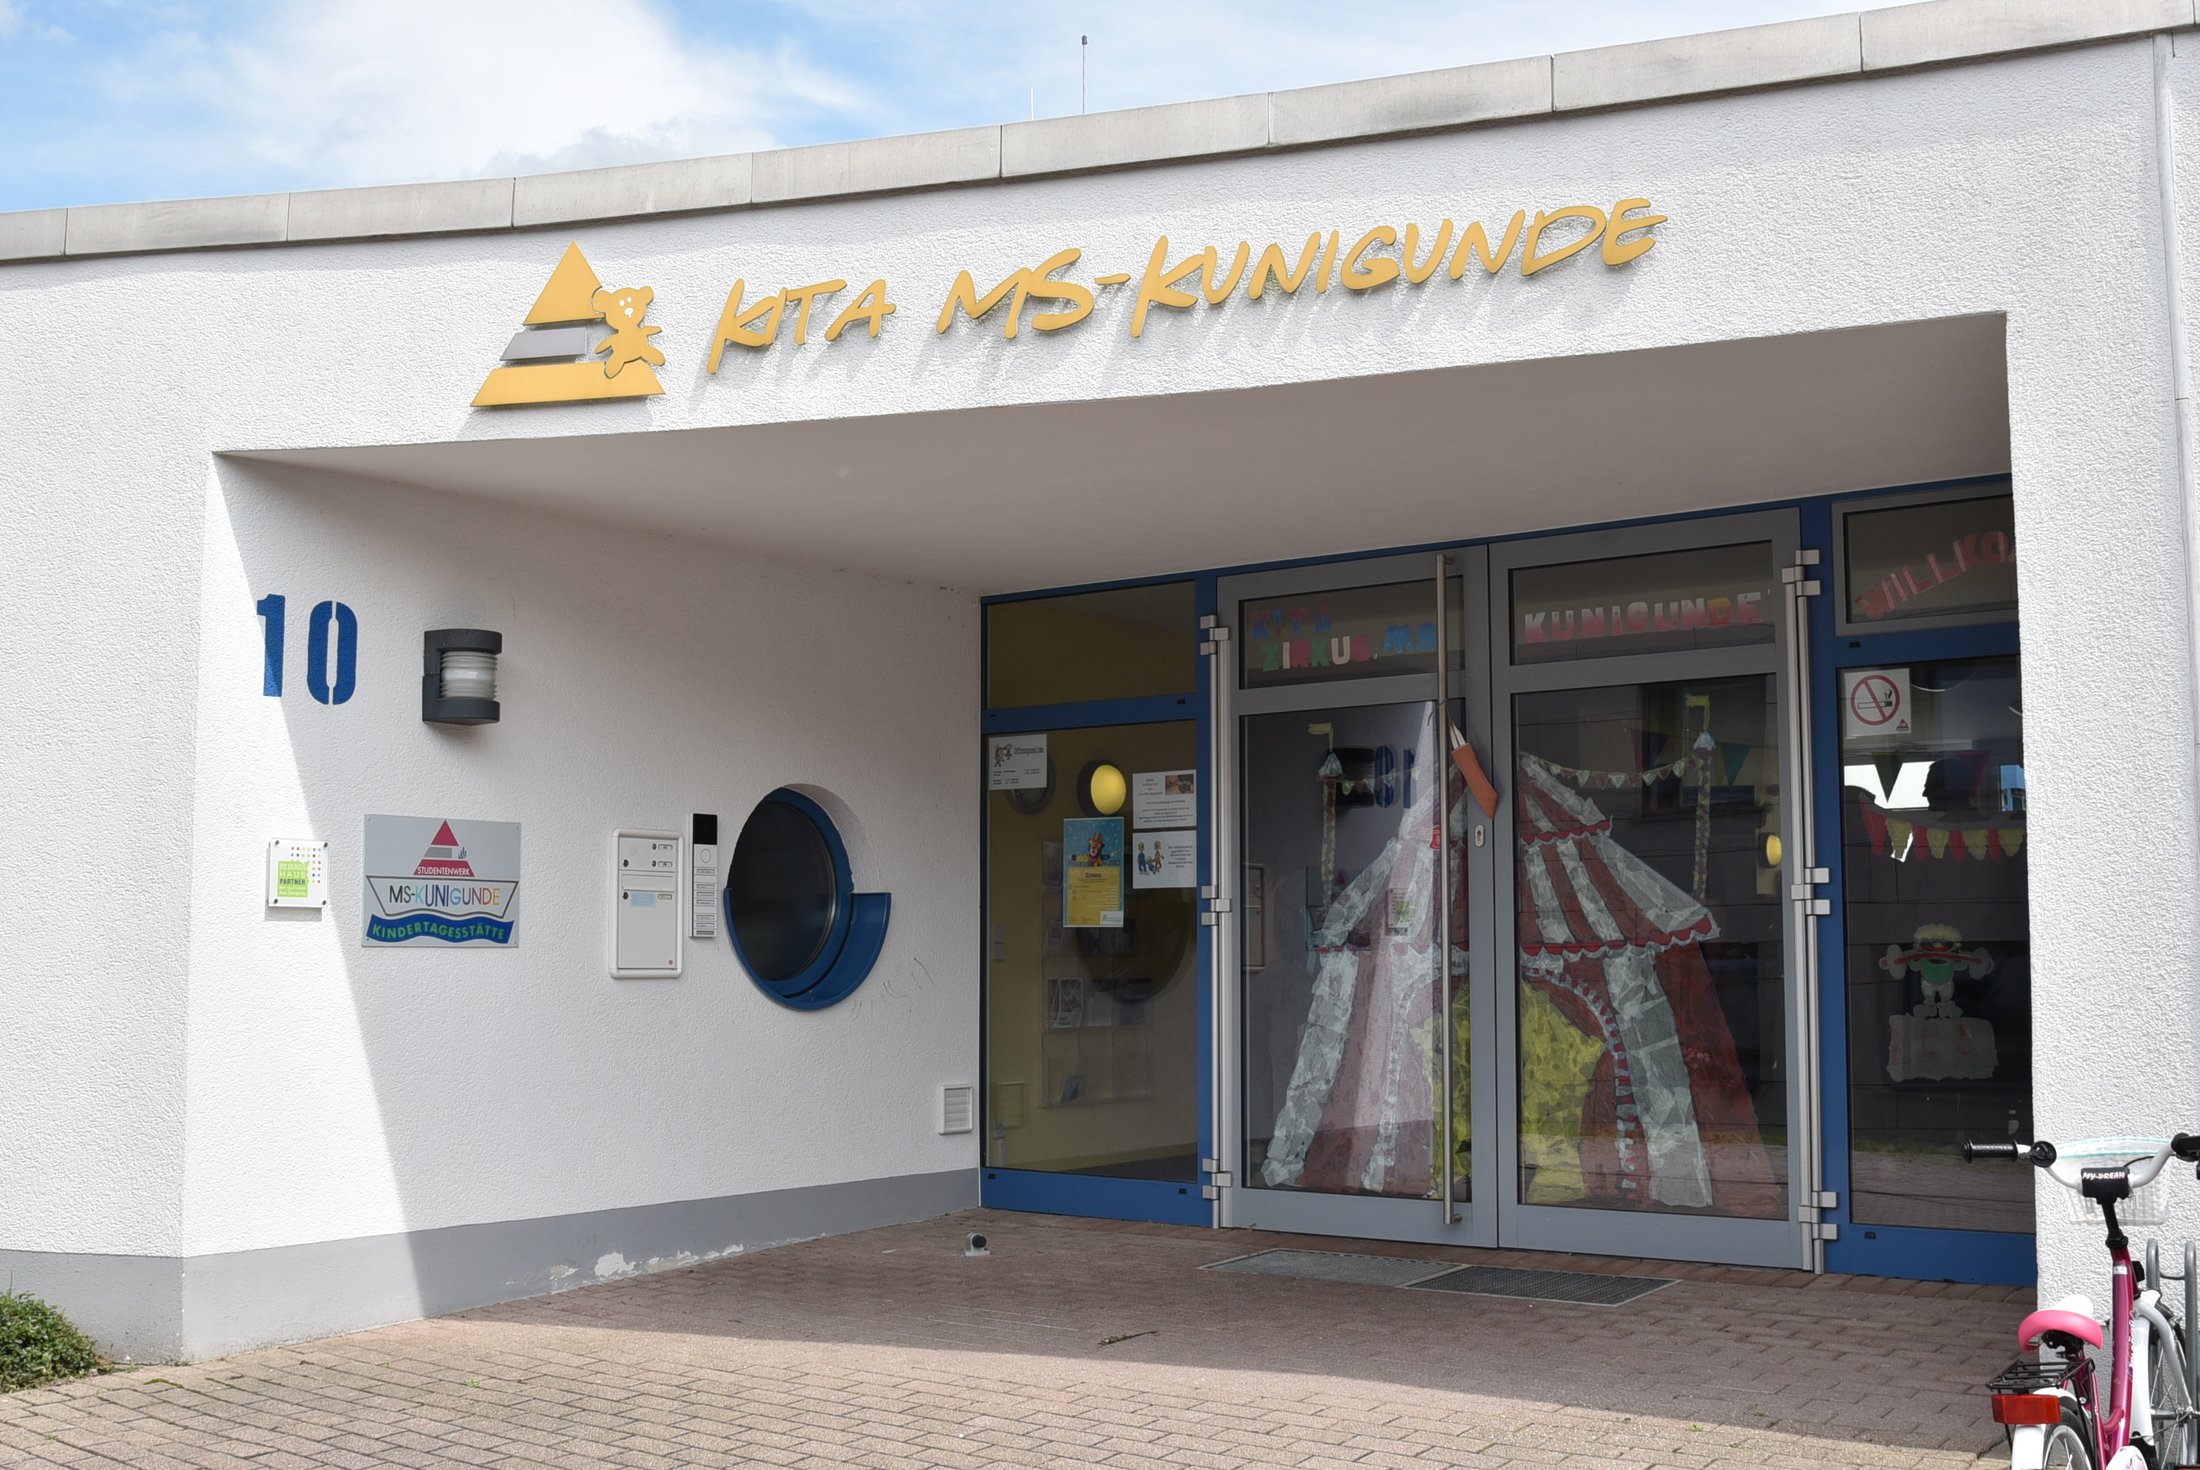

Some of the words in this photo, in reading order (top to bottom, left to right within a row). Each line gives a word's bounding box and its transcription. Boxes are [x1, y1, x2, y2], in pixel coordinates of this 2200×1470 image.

[707, 278, 896, 374] KITA
[936, 198, 1668, 339] MS-KUNIGUNDE
[1855, 530, 2017, 620] WILLKO
[1250, 602, 1332, 641] KITA
[256, 593, 358, 705] 10
[279, 870, 307, 879] HAUS
[279, 878, 306, 886] PARTNER
[417, 866, 471, 876] STUDENTENWERK
[389, 884, 500, 907] MS-KUNIGUNDE
[372, 921, 505, 940] KINDERTAGESSTÄTTE
